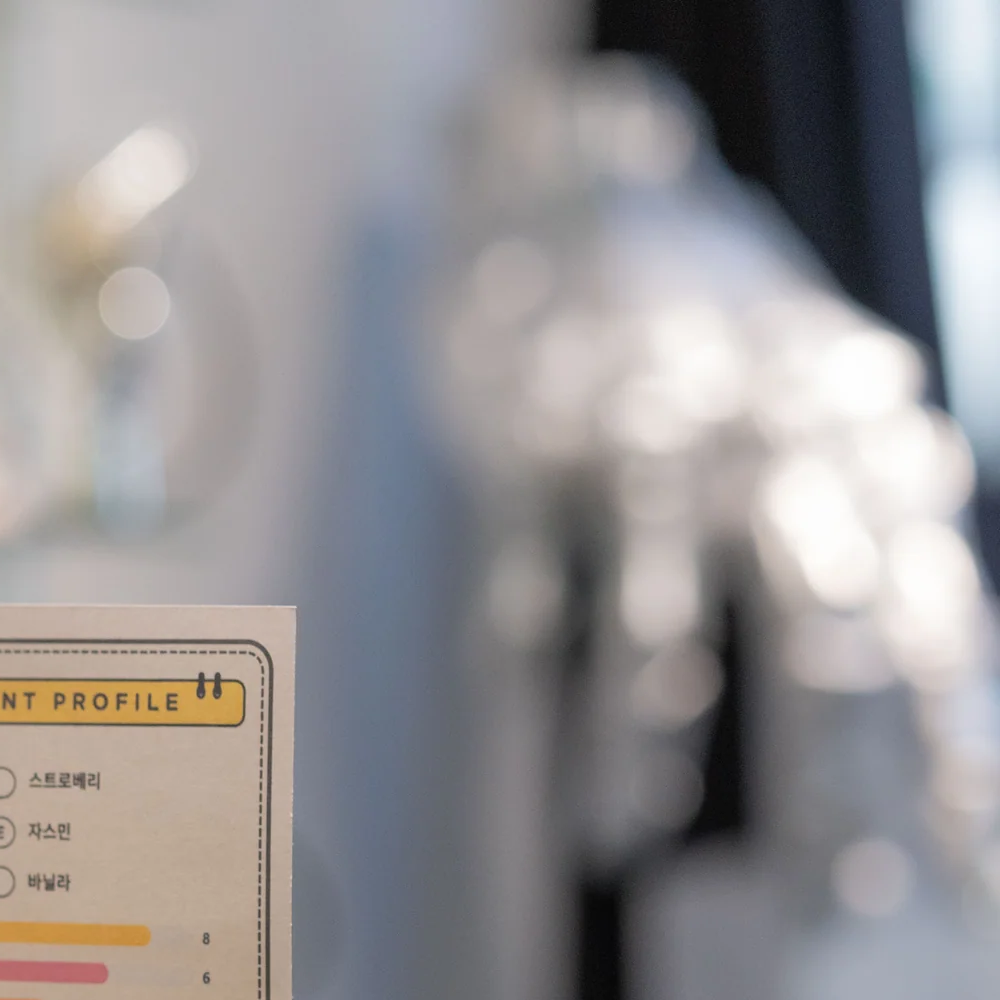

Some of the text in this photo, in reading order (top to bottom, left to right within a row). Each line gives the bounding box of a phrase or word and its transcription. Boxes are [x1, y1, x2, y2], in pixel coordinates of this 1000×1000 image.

[53, 692, 179, 711] PROFILE
[29, 772, 101, 790] 스트로베리
[28, 822, 71, 841] 자스민
[27, 873, 71, 892] 바닐라
[202, 932, 211, 945] 8
[202, 971, 211, 985] 6
